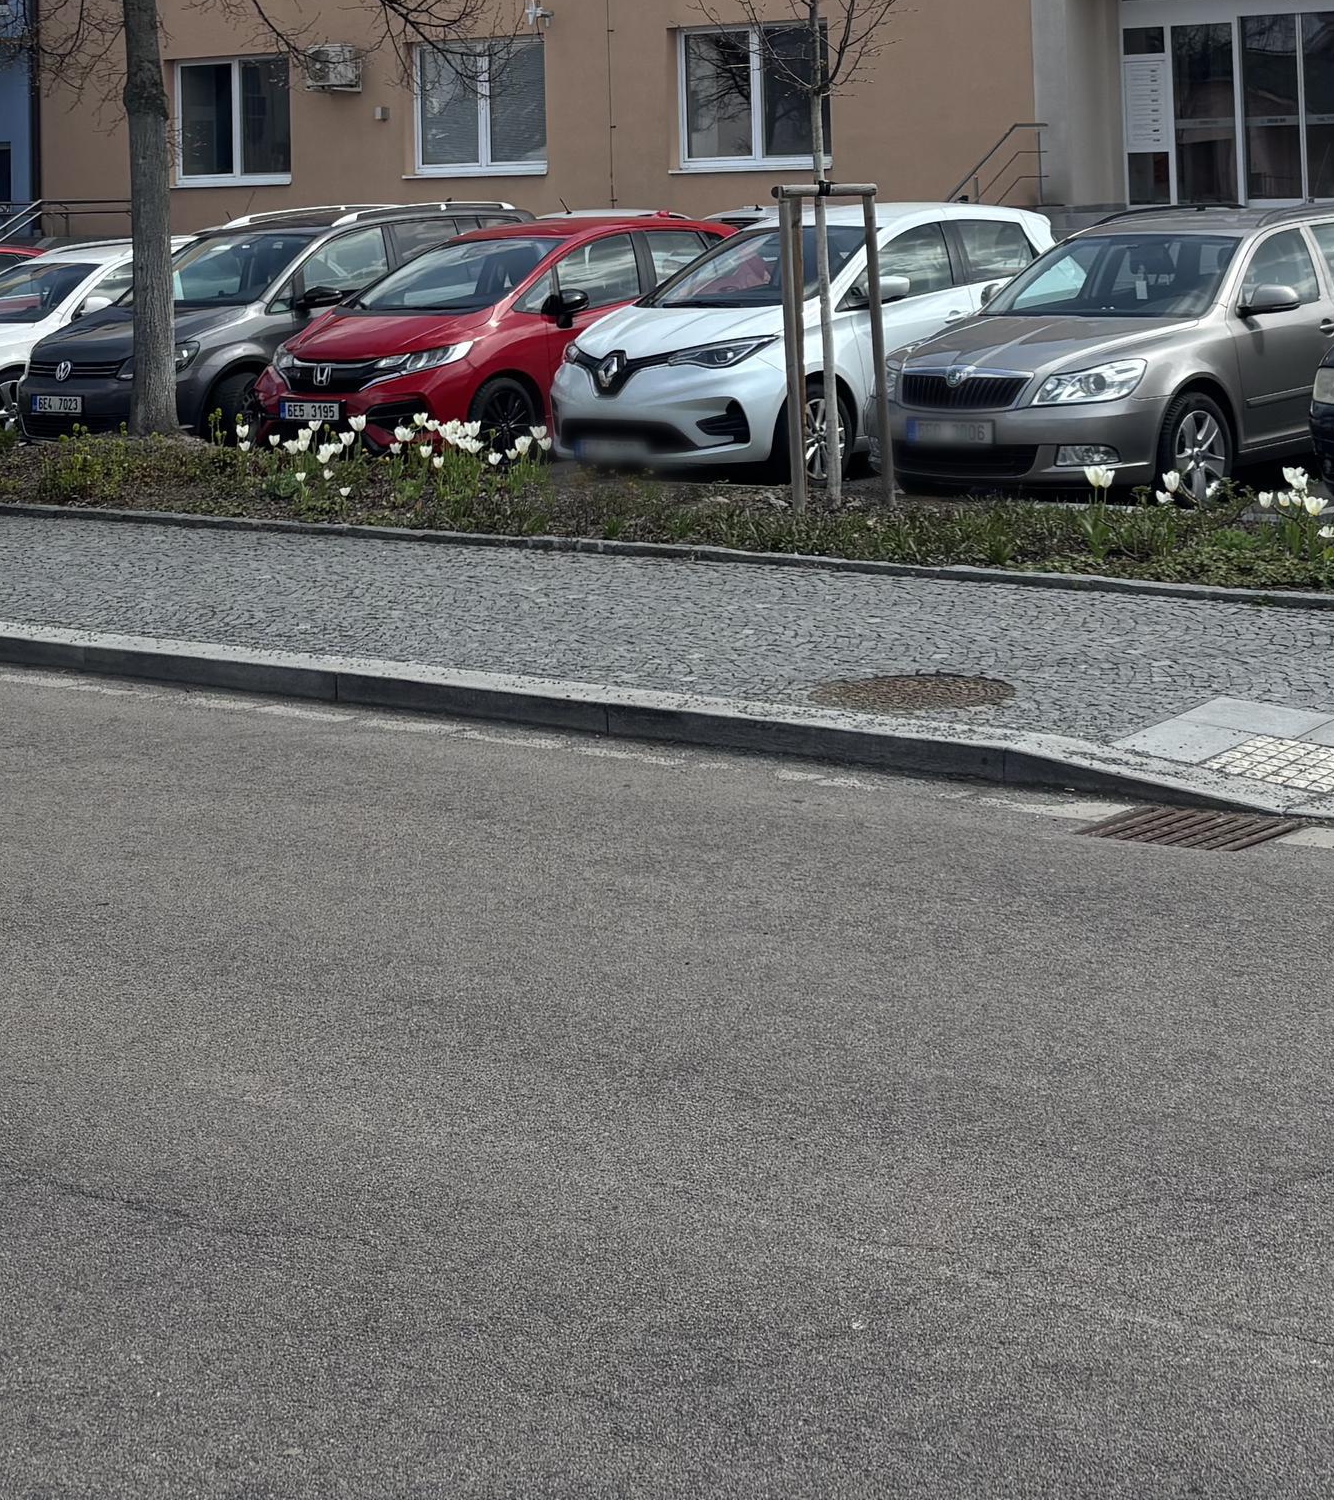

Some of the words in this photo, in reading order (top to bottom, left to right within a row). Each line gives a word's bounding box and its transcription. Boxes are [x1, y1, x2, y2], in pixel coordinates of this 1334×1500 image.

[39, 397, 52, 410] 6E4
[58, 398, 78, 411] 7023
[287, 404, 305, 418] 6E5
[311, 405, 335, 419] 3195
